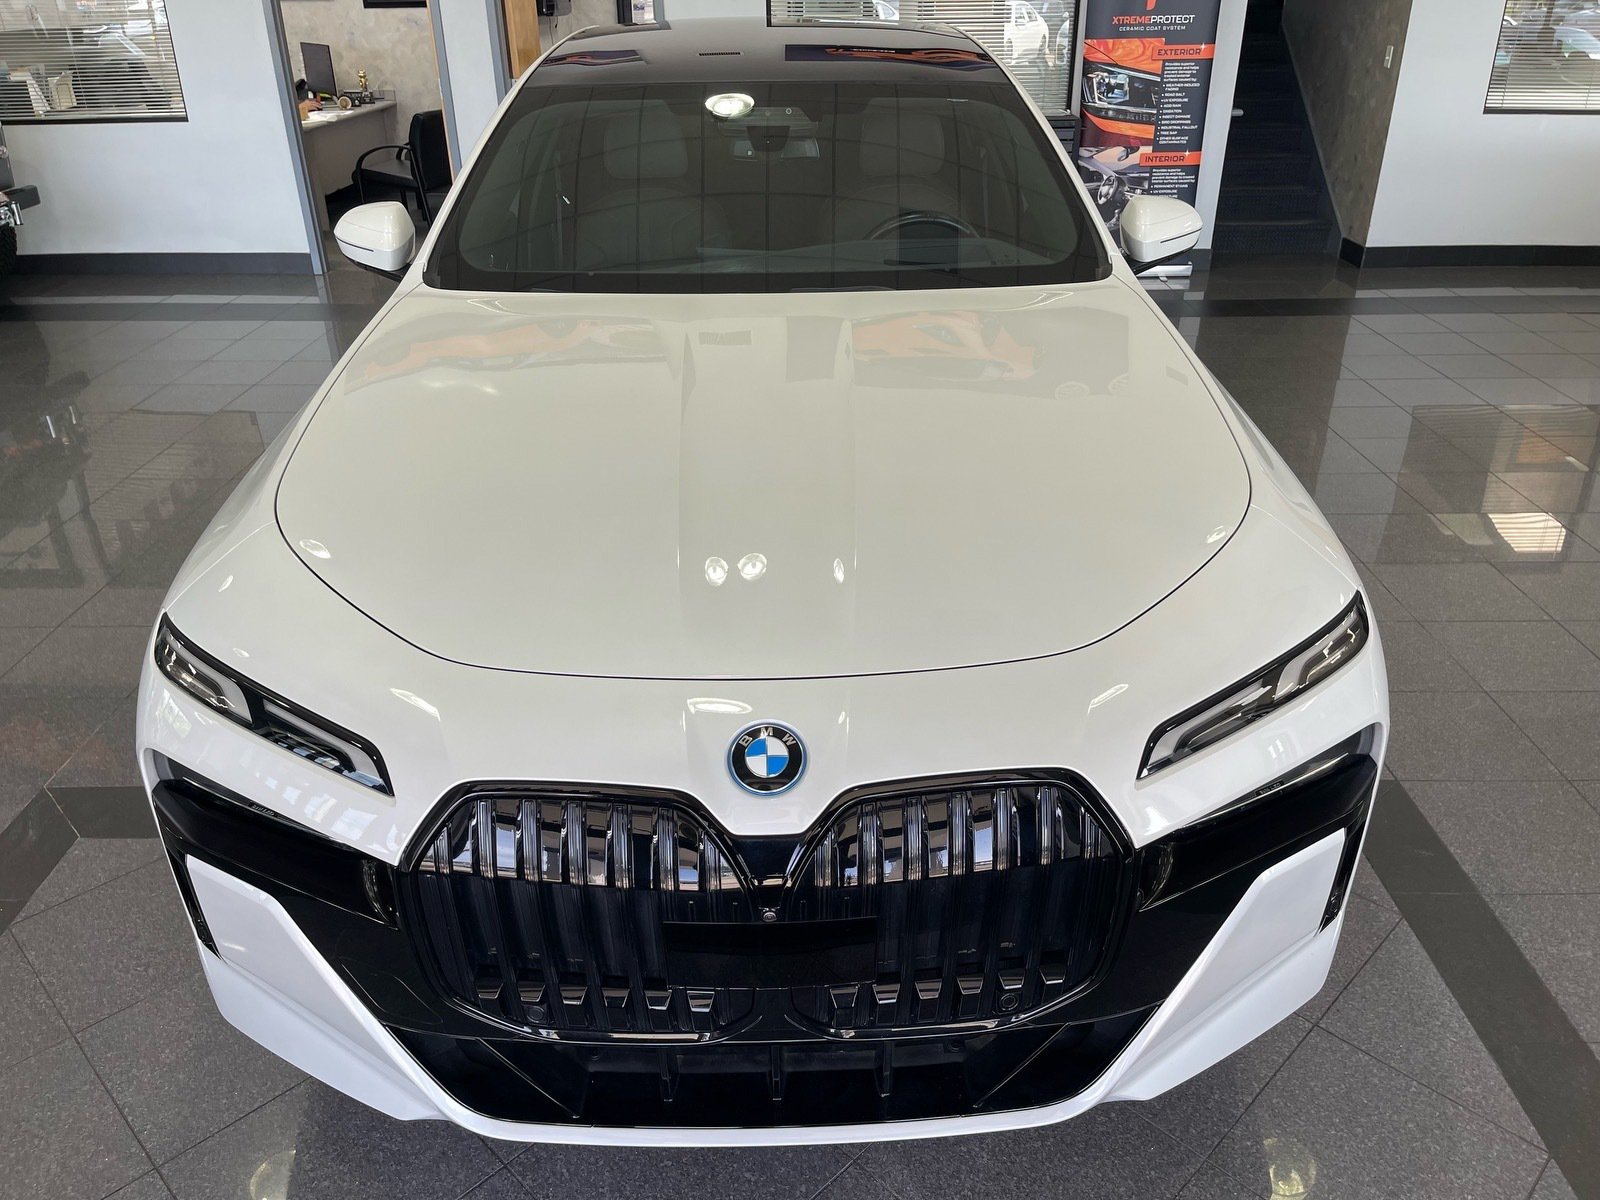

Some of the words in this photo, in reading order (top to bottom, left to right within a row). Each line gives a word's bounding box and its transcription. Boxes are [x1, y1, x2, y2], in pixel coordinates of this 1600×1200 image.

[1112, 15, 1195, 25] XTREMEPROTECT
[1157, 48, 1201, 56] EXTERIOR
[738, 727, 797, 748] BMW
